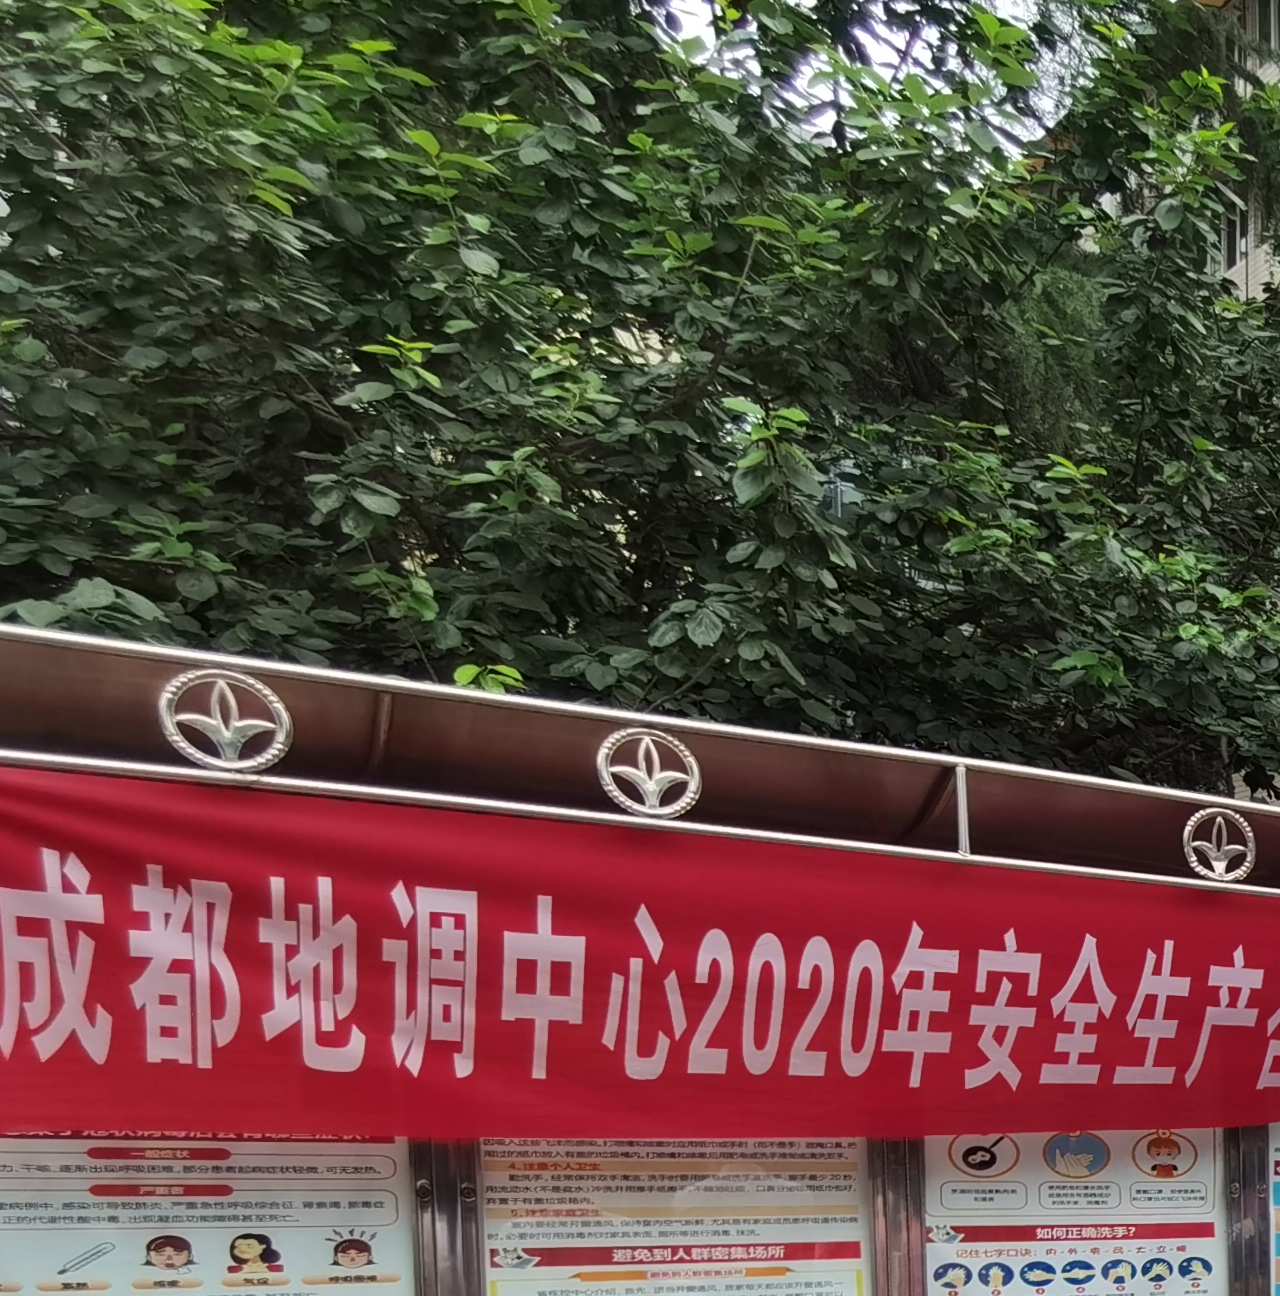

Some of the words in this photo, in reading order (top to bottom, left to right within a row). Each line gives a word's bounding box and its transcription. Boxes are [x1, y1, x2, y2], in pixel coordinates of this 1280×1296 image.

[612, 1246, 785, 1263] 避免到人群密集场所
